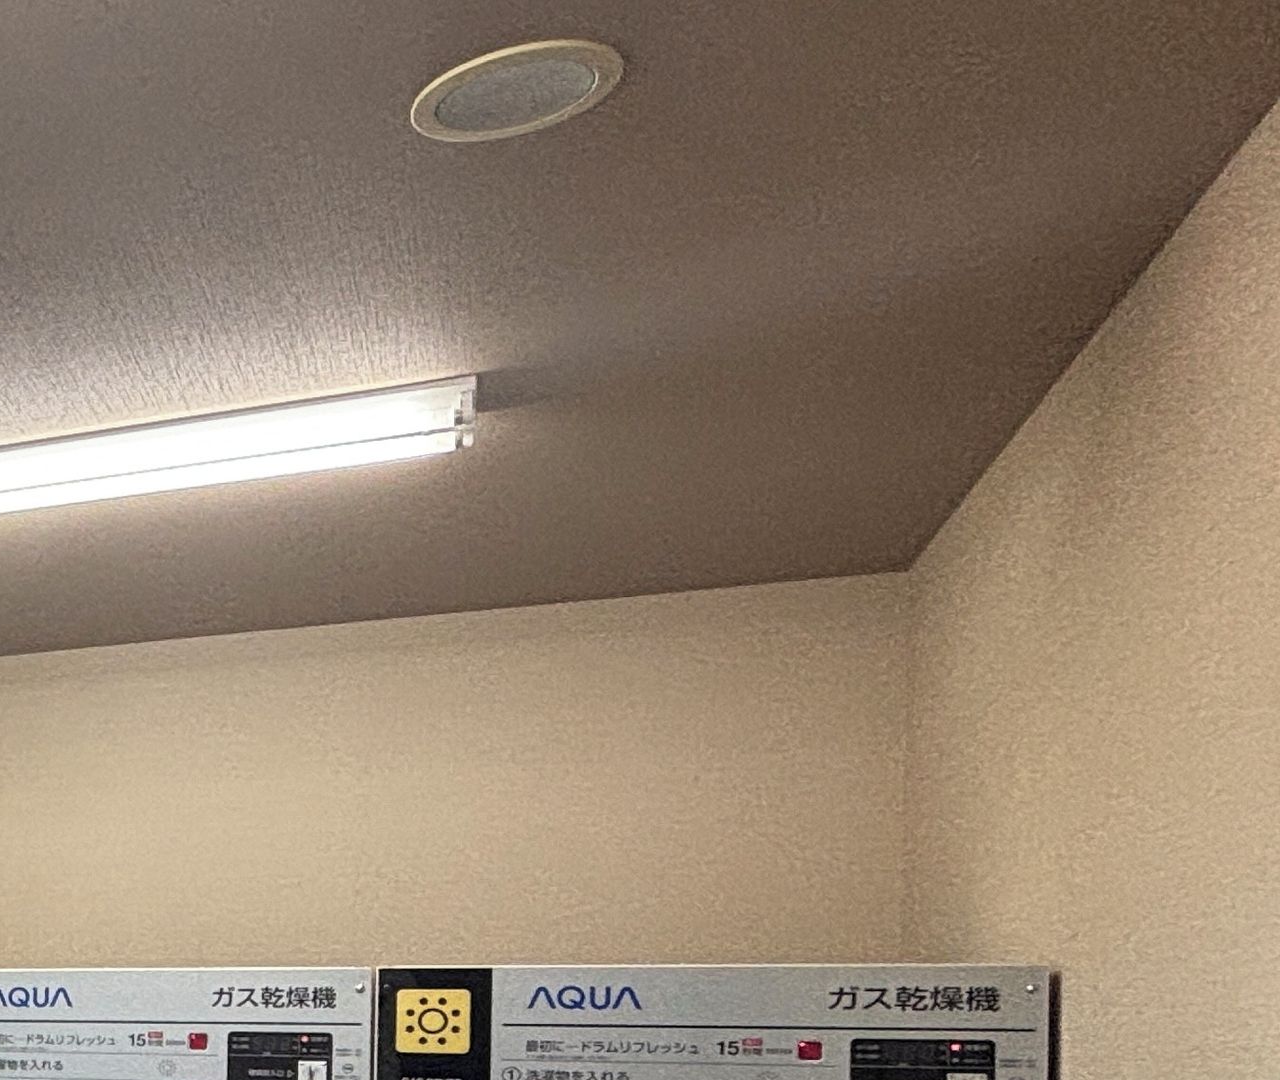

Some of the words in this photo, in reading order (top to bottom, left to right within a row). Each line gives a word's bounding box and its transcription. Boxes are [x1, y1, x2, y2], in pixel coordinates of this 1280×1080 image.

[211, 985, 337, 1010] ガス乾燥機
[527, 985, 643, 1011] AQUA
[828, 985, 1001, 1013] ガス乾燥機
[127, 1033, 147, 1047] 15
[717, 1040, 740, 1056] 15
